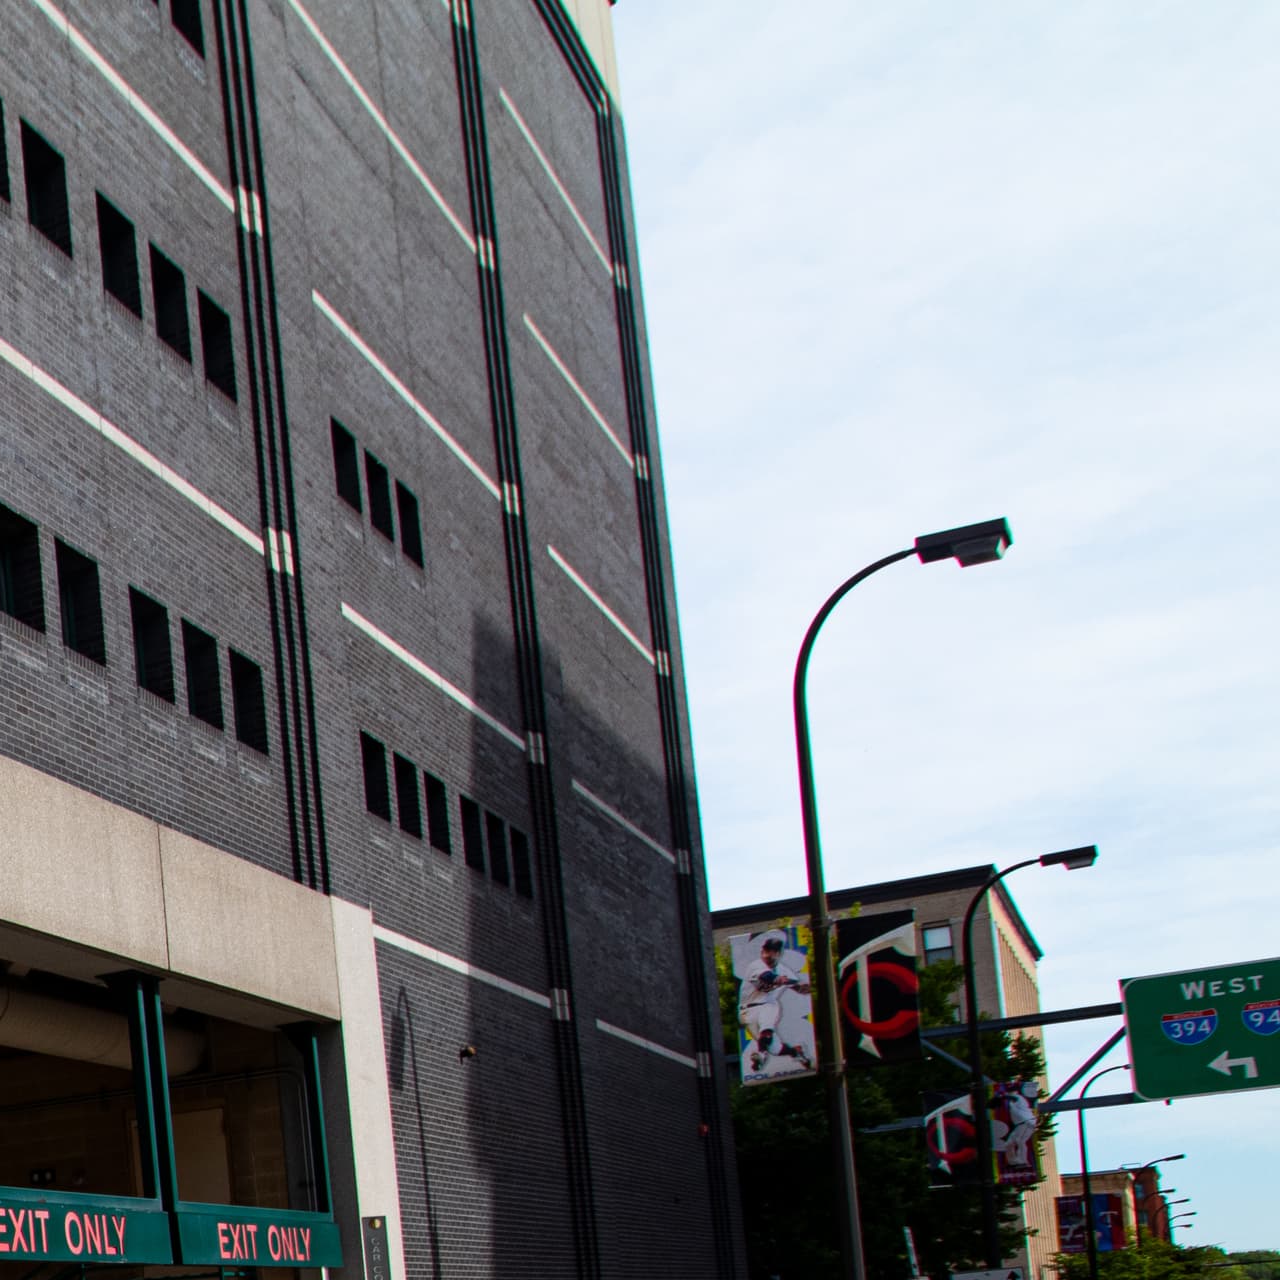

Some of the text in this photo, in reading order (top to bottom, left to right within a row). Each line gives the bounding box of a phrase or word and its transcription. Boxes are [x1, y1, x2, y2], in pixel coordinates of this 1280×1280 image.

[1180, 975, 1264, 1001] WEST
[1170, 1009, 1280, 1039] 394 94
[64, 1211, 127, 1256] ONLY
[217, 1221, 312, 1262] EXIT ONLY
[370, 1237, 383, 1262] CAR
